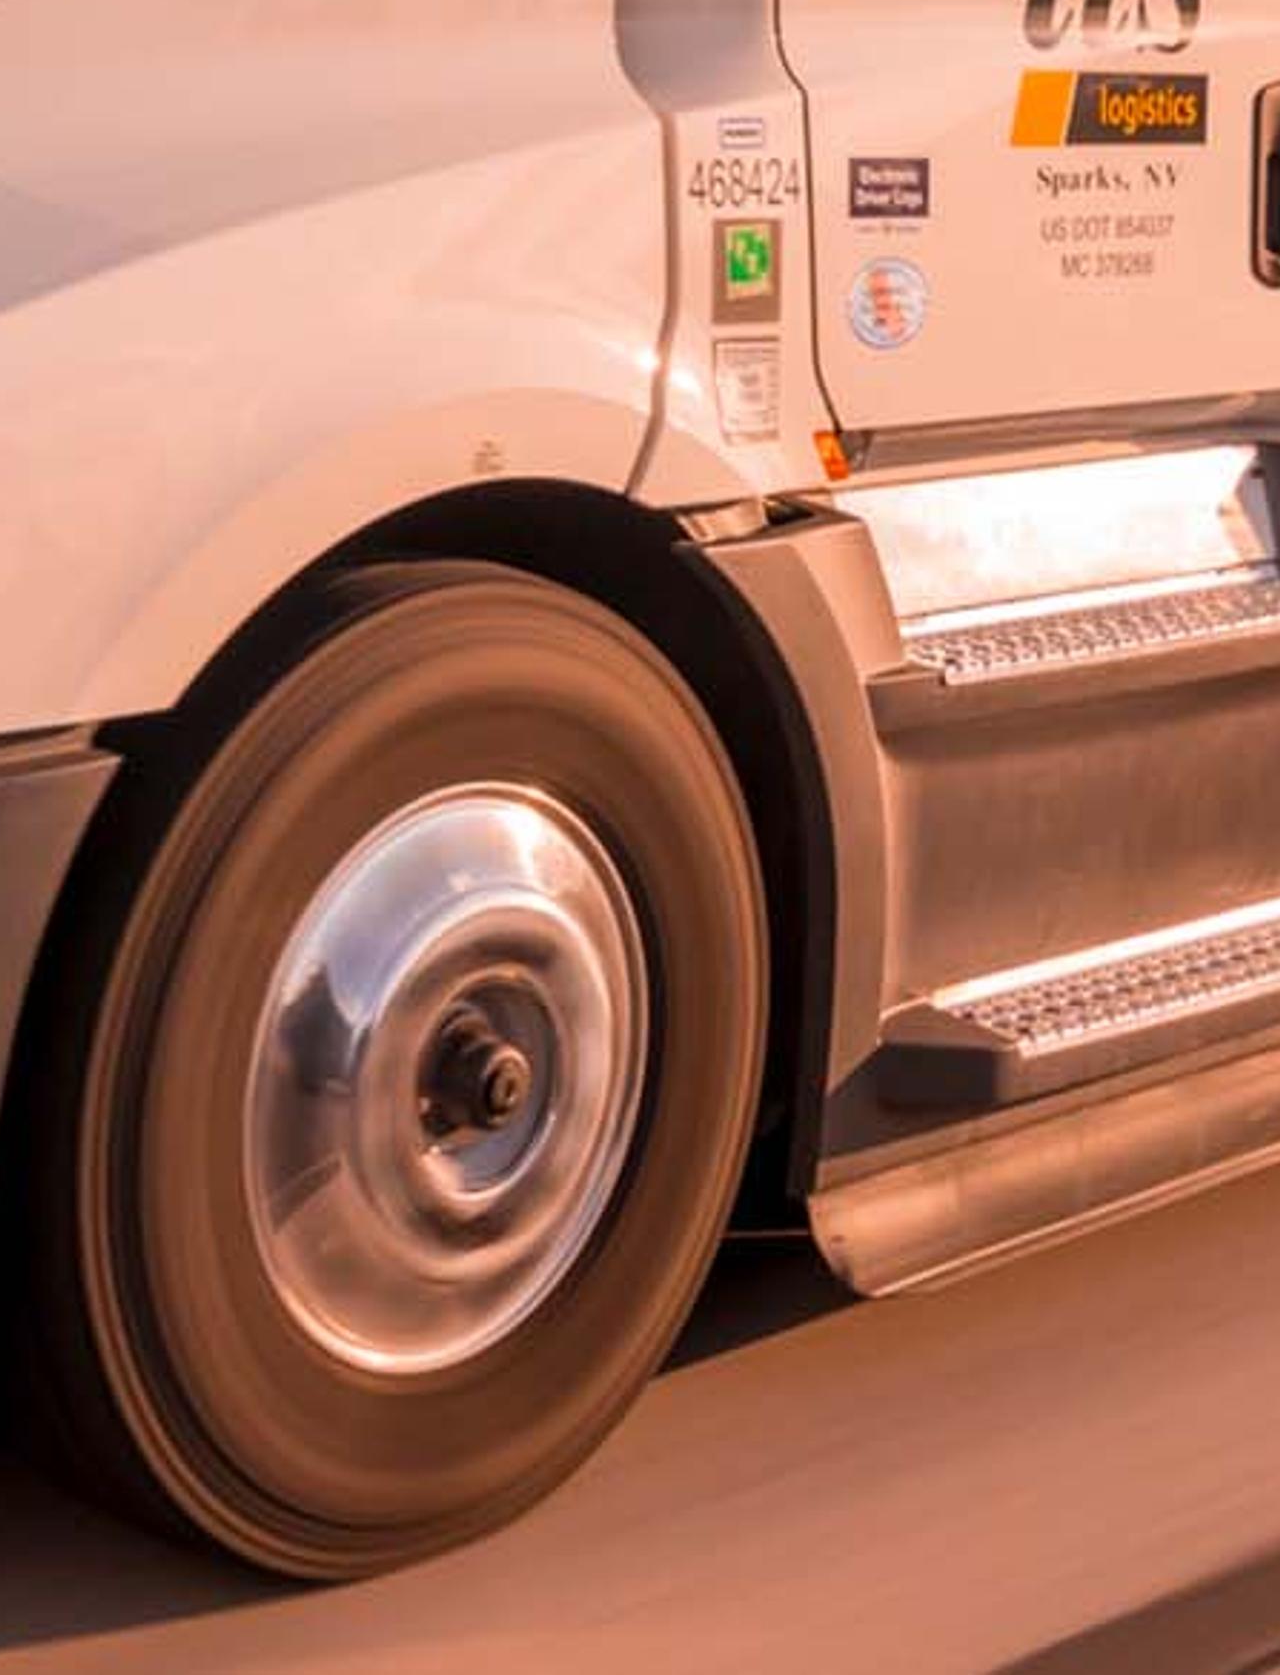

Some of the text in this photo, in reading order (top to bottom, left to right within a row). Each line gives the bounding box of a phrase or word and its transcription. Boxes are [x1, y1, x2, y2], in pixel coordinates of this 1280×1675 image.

[1098, 83, 1198, 134] logistics
[687, 157, 801, 208] 468424
[1039, 215, 1067, 243] US
[1070, 214, 1111, 242] DOT
[1060, 252, 1091, 278] MC
